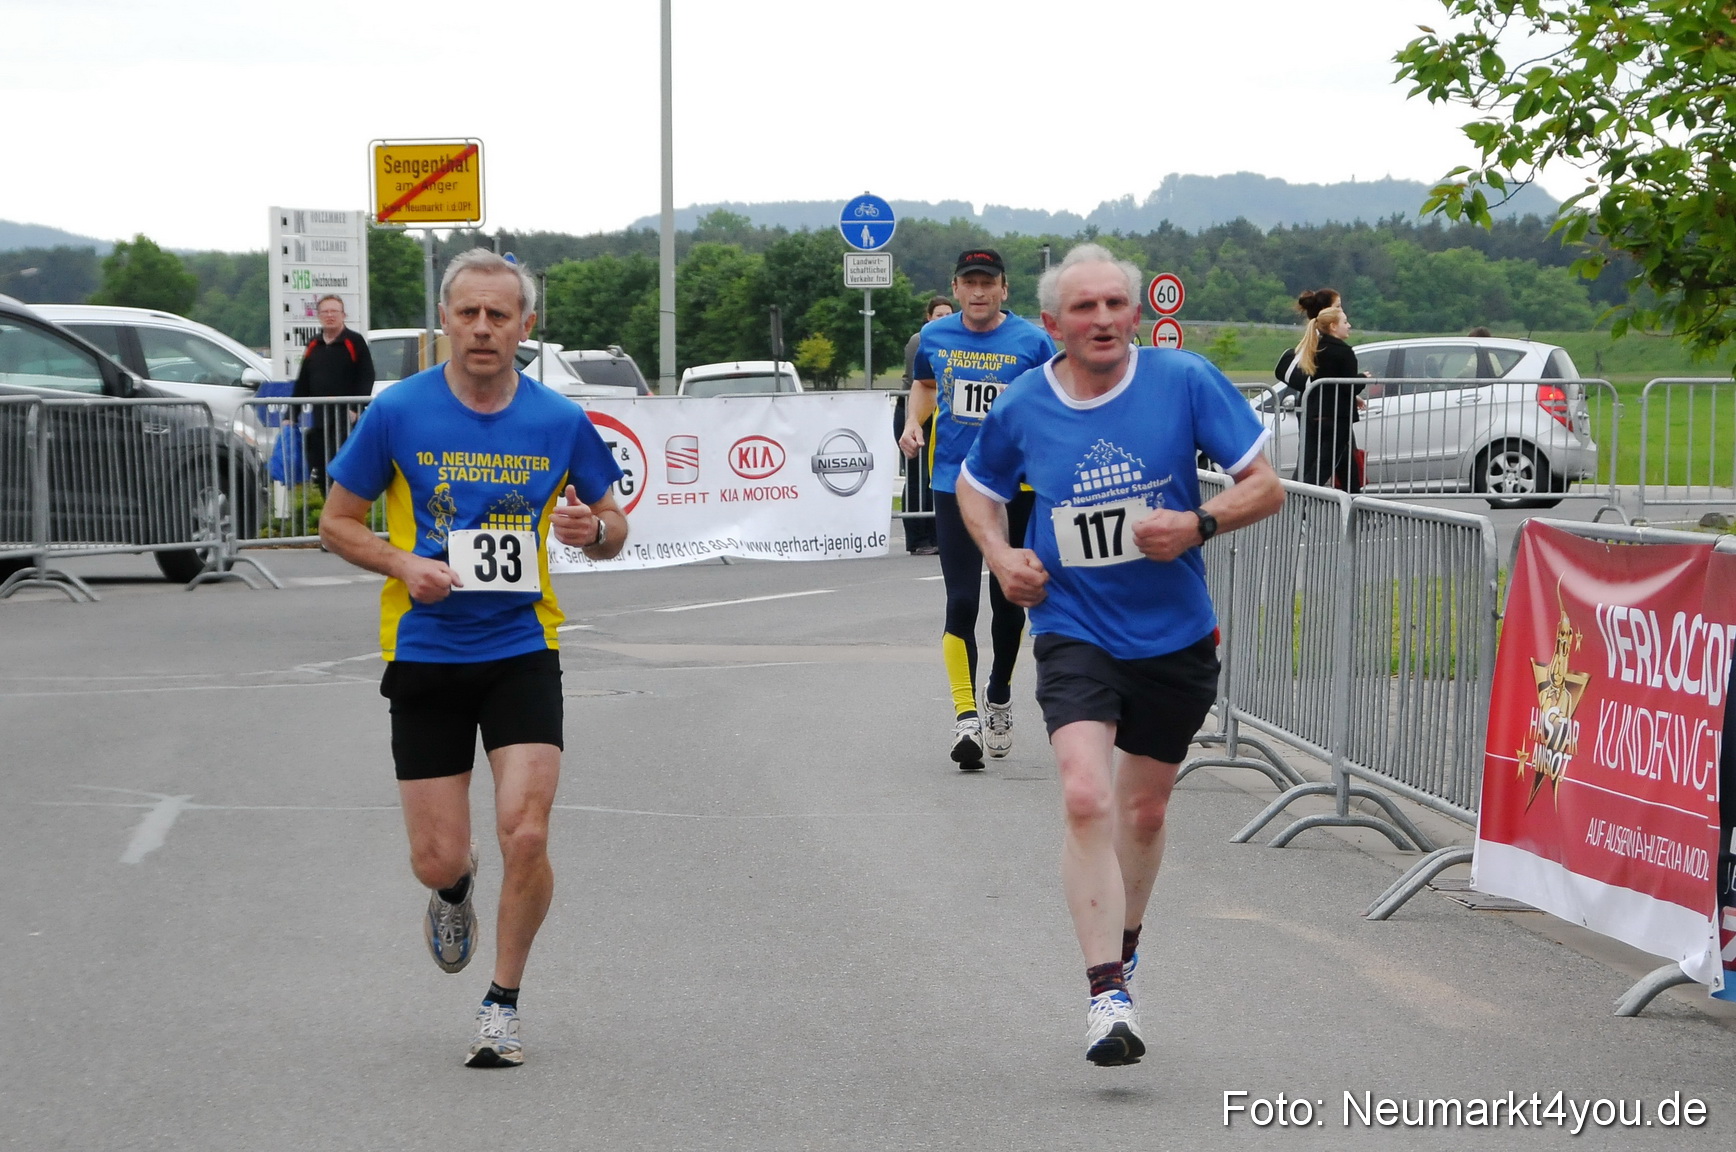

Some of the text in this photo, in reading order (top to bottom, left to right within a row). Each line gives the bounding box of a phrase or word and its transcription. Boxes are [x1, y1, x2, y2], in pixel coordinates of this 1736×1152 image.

[384, 154, 470, 178] Sengenthal
[395, 181, 458, 193] am Anger
[405, 202, 443, 212] Neumarkt
[292, 269, 311, 290] SHB
[850, 266, 887, 274] schaftlicher
[850, 275, 888, 283] Verkehr frei
[1157, 285, 1176, 303] 60
[938, 349, 1017, 365] 10. NEUMARKTER
[946, 358, 1003, 371] STADTLAUF
[964, 383, 998, 413] 119
[416, 452, 550, 471] 10. NEUMARKTER
[738, 446, 775, 469] KIA
[817, 456, 868, 469] NISSAN
[438, 466, 531, 485] STADTLAUF
[657, 492, 710, 506] SEAT
[720, 485, 799, 503] KIA MOTORS
[1072, 486, 1130, 505] Neumarkter
[1131, 474, 1173, 492] Stadtlauf
[1073, 507, 1126, 559] 117
[634, 543, 655, 560] Tel.
[746, 531, 887, 556] www.gerhart-jaenig.de
[473, 533, 522, 583] 33
[1585, 817, 1606, 847] AUF
[1665, 839, 1682, 873] KIA
